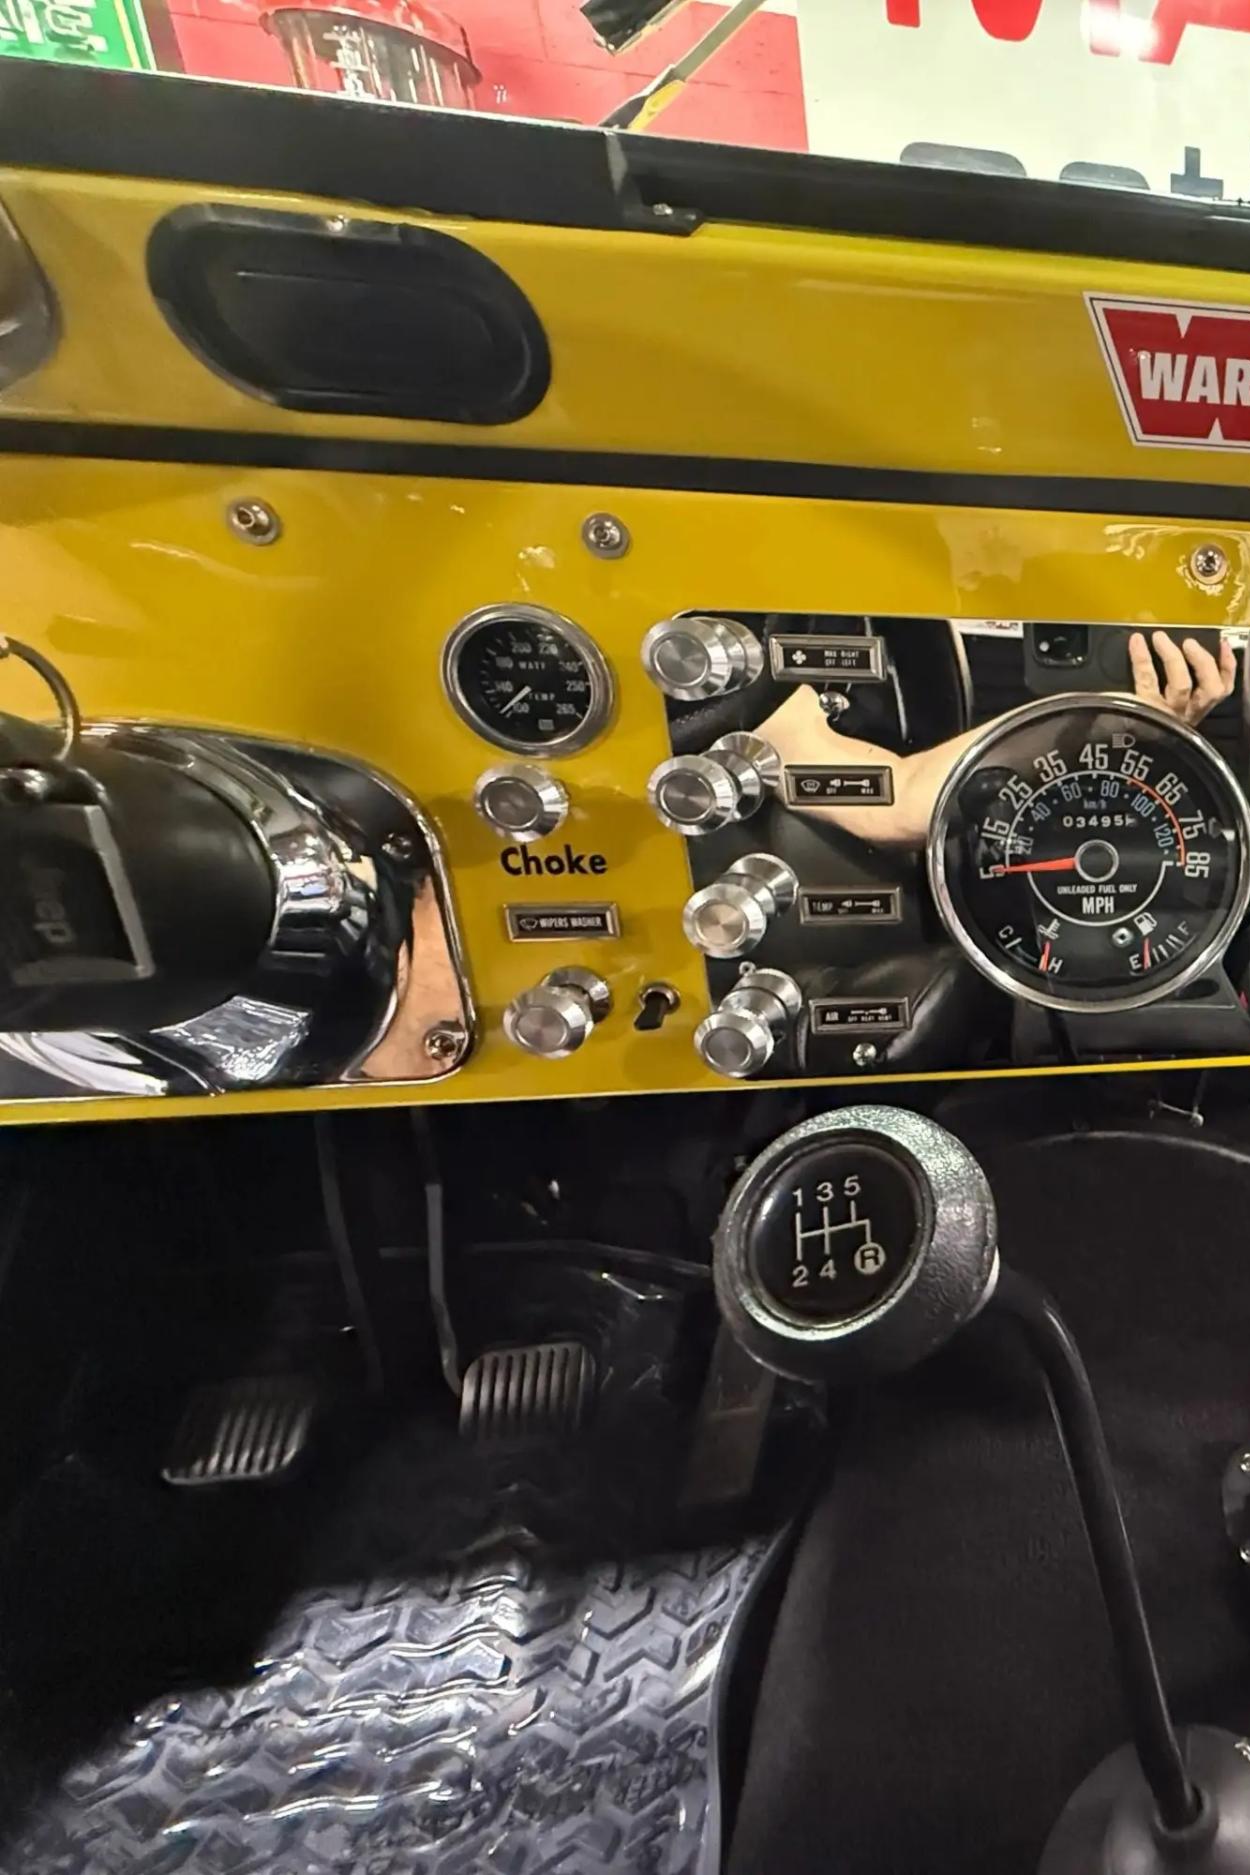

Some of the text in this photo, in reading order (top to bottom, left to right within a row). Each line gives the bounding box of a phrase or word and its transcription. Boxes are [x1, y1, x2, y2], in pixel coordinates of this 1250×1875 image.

[1033, 749, 1068, 782] 35
[1079, 743, 1109, 769] 45
[1120, 749, 1153, 781] 55
[998, 775, 1033, 810] 25
[1061, 782, 1082, 802] 60
[1101, 780, 1120, 798] 80
[1155, 772, 1188, 805] 65
[1031, 802, 1052, 822] 40
[1130, 793, 1156, 818] 100
[980, 816, 1010, 841] 15
[1153, 823, 1175, 848] 120
[1178, 809, 1208, 840] 75
[500, 844, 608, 876] Choke
[1184, 851, 1211, 878] 85
[1057, 884, 1137, 895] UNLEADED FUEL ONLY
[1082, 897, 1114, 914] MPH
[540, 917, 569, 929] WIPERS
[998, 925, 1014, 939] C
[1177, 921, 1190, 935] F
[1048, 957, 1063, 974] H
[1128, 954, 1142, 970] E
[792, 1175, 861, 1206] 1 3 5
[792, 1248, 881, 1287] 2 4 R
